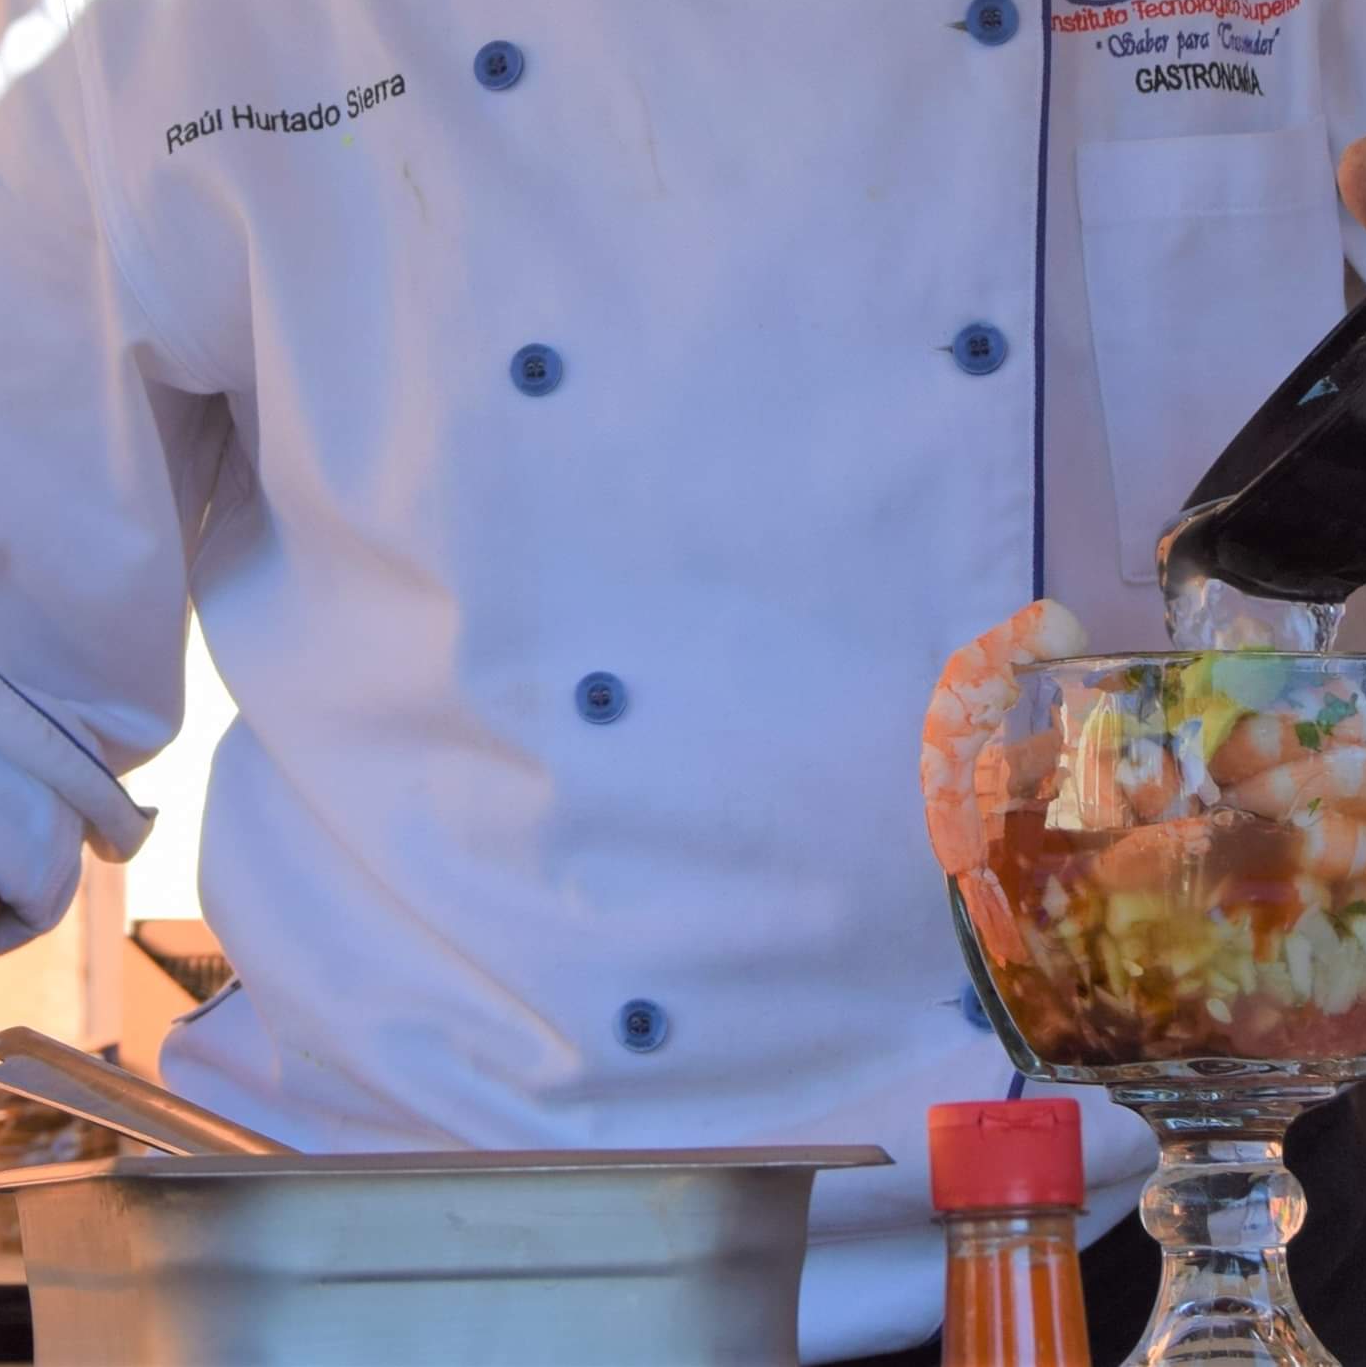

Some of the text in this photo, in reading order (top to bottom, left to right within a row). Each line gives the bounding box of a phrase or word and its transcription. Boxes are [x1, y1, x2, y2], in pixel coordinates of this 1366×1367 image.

[1050, 8, 1128, 33] nstituto
[1177, 31, 1209, 58] para
[165, 73, 406, 154] Raúl Hurtado Sierra
